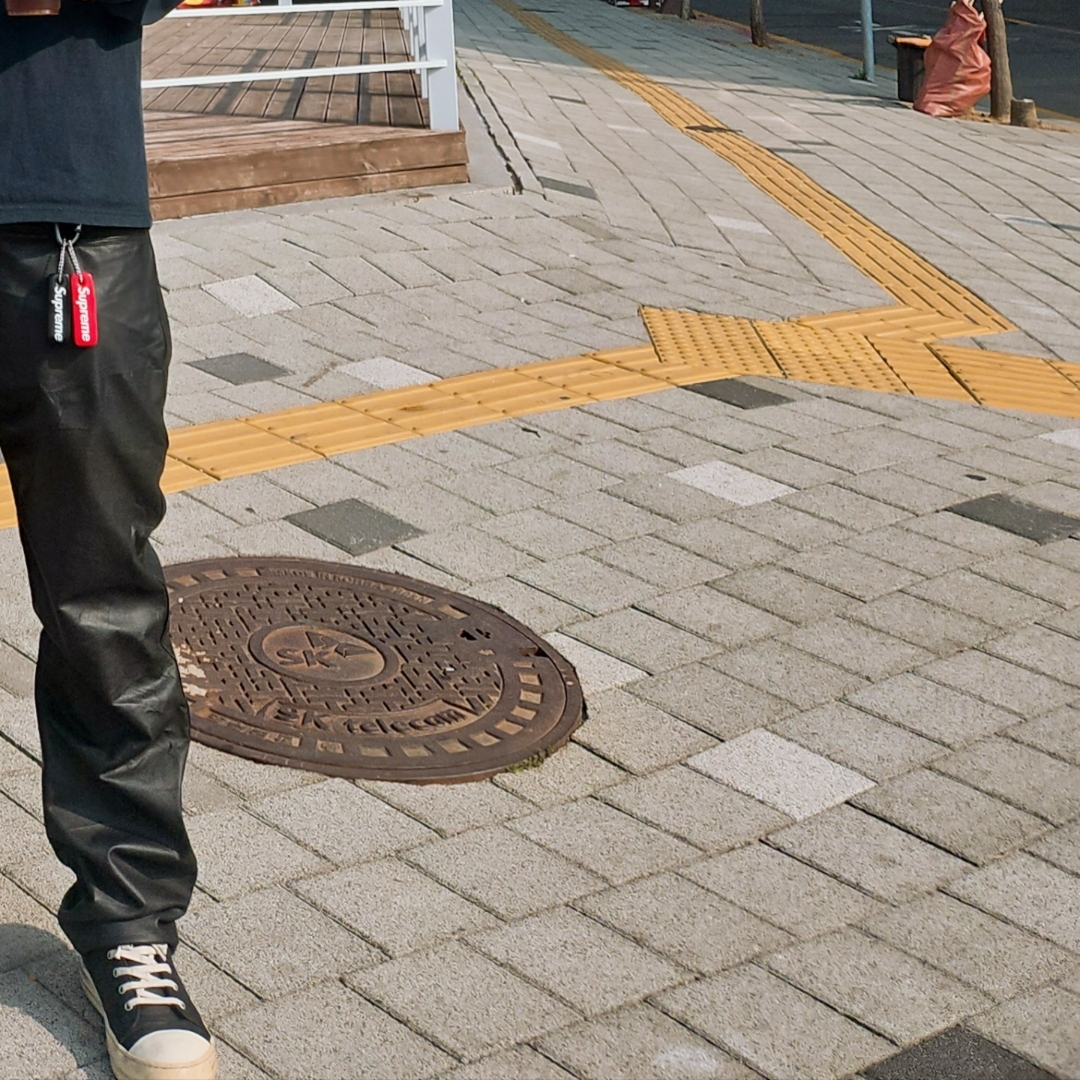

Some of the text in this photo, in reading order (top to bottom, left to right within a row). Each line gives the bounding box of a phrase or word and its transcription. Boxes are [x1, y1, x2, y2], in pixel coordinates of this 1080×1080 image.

[51, 284, 67, 342] Supreme
[75, 286, 91, 342] Supreme
[276, 648, 340, 670] SK
